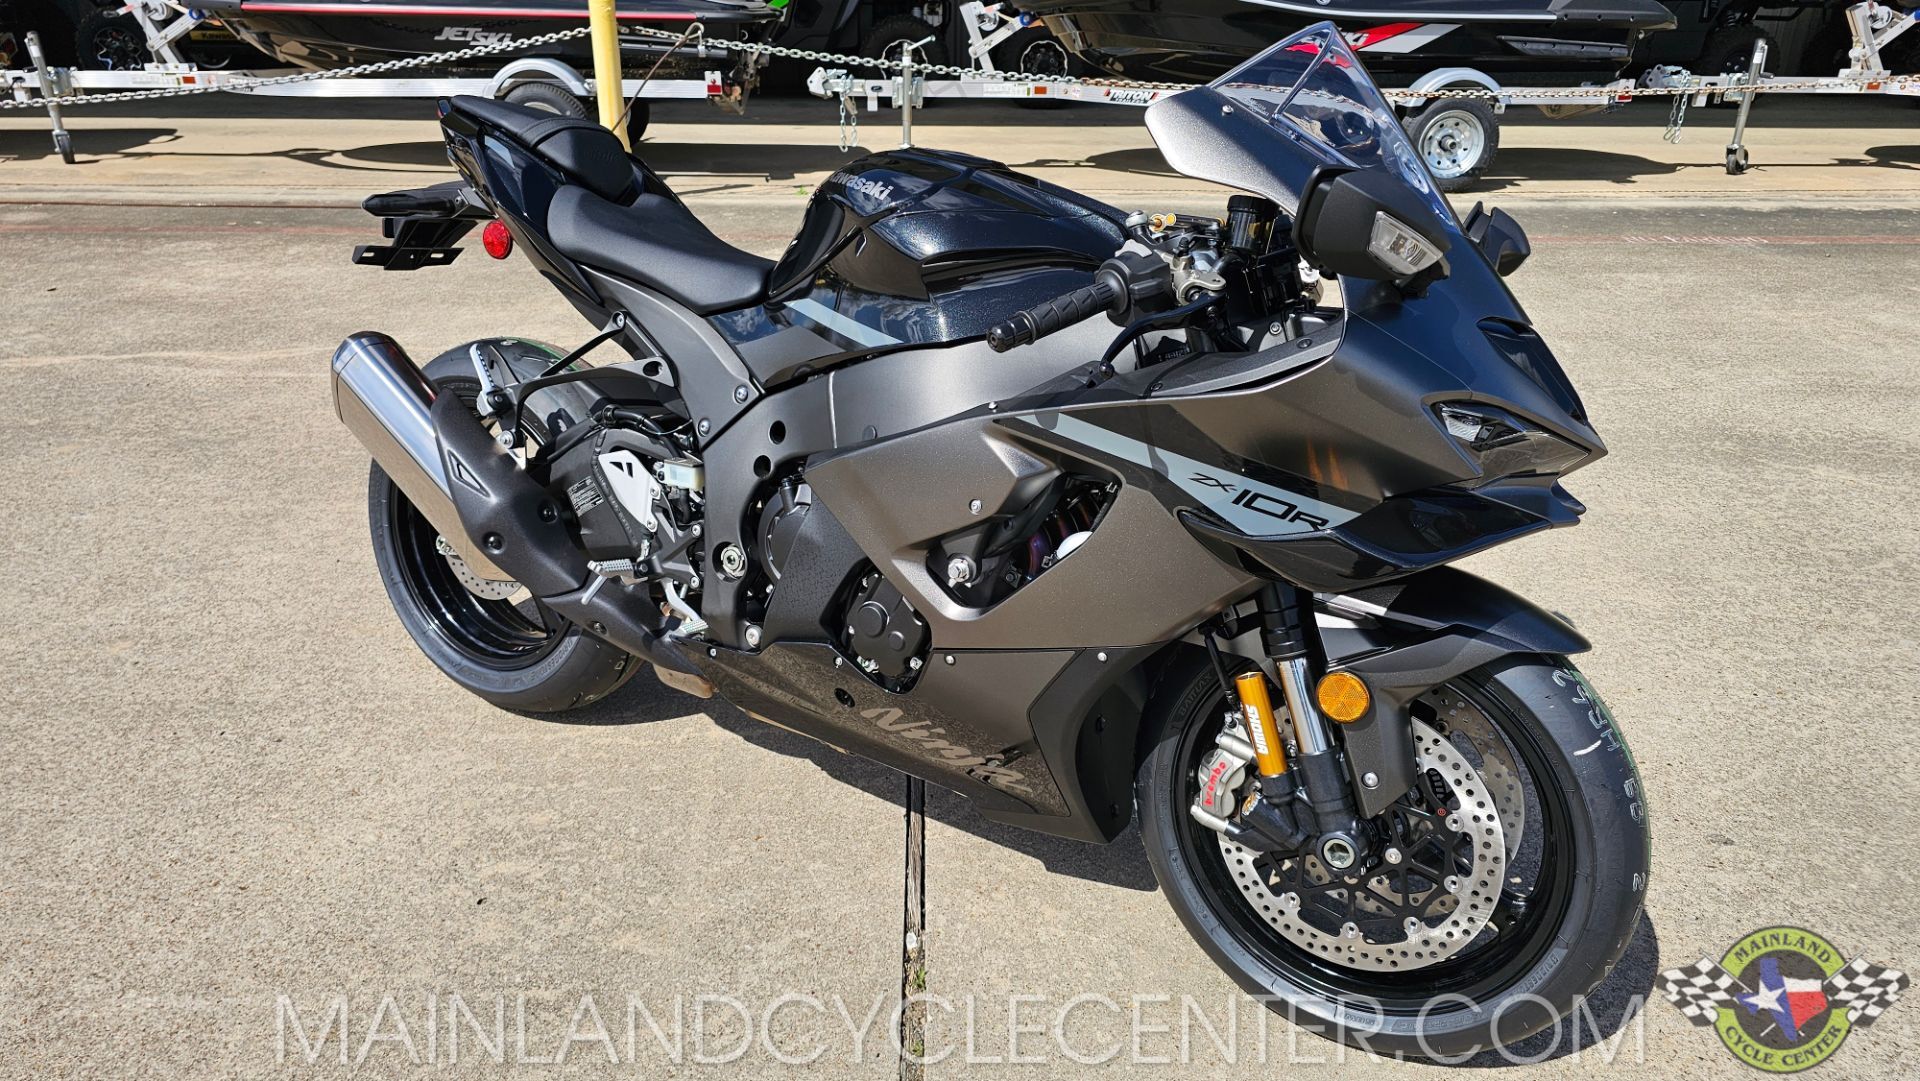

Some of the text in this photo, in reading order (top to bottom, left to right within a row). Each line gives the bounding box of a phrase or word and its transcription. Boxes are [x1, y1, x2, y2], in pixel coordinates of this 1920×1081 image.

[1188, 472, 1330, 531] ZX-10R
[860, 707, 1034, 793] Ninja
[1245, 704, 1269, 755] SHOWA
[1204, 761, 1227, 807] brembo
